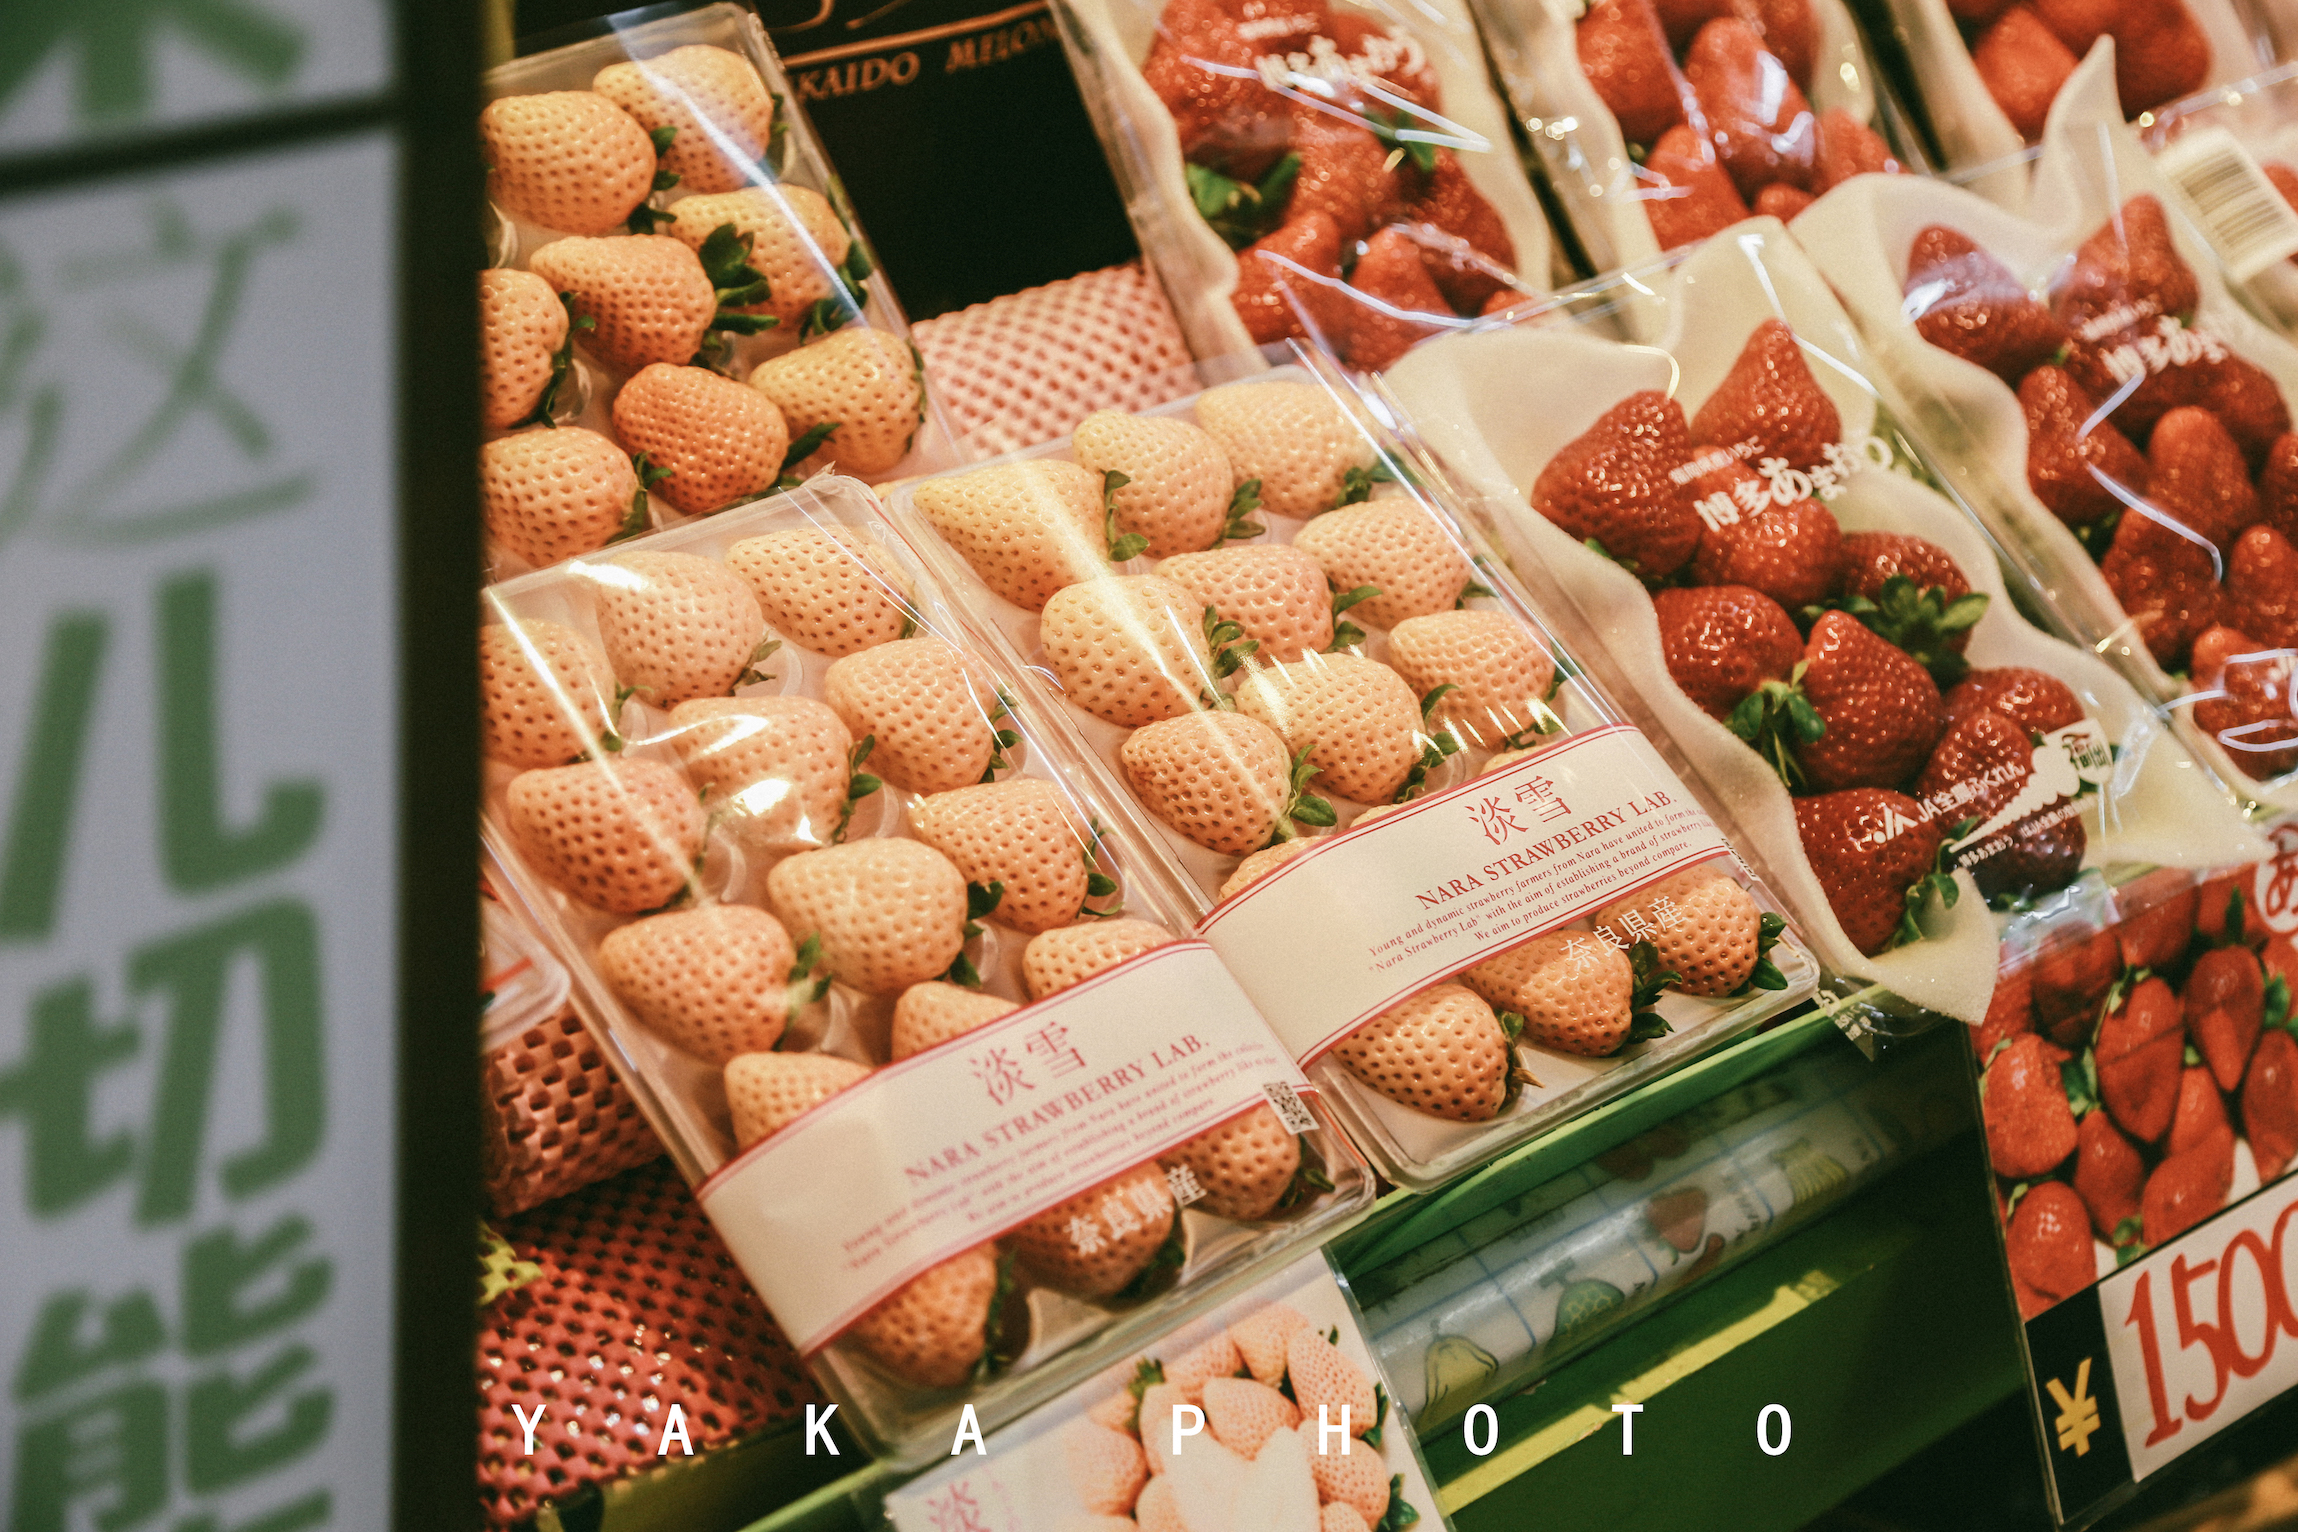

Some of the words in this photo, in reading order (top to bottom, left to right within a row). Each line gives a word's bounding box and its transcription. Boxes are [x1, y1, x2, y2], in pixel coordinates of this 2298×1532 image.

[793, 51, 922, 101] KAIDO
[1415, 873, 1485, 911] NARA
[1482, 806, 1628, 882] STRAWBERRY
[1628, 790, 1679, 817] LAB.
[1464, 775, 1572, 846] 淡雪
[1368, 934, 1406, 957] Young
[1404, 921, 1426, 940] and
[1425, 906, 1466, 930] dynamic
[1465, 885, 1516, 912] strawberry
[1515, 868, 1554, 893] farmers
[1552, 856, 1579, 876] from
[1575, 846, 1603, 860] Nara
[1600, 835, 1625, 851] have
[1625, 820, 1656, 841] united
[1664, 810, 1686, 826] form
[1403, 926, 1460, 957] Strawberry
[1485, 904, 1508, 920] with
[1506, 898, 1524, 911] the
[1524, 889, 1545, 904] aim
[1555, 858, 1614, 890] establishing
[1618, 839, 1649, 860] brand
[1660, 821, 1702, 842] strawberry
[1473, 929, 1491, 942] We
[1491, 921, 1512, 936] aim
[1522, 899, 1561, 924] produce
[1560, 873, 1619, 904] strawberries
[1616, 854, 1652, 878] beyond
[1652, 841, 1693, 862] compare.
[1560, 895, 1690, 972] 奈良県産
[903, 1140, 982, 1186] NARA
[982, 1058, 1147, 1149] STRAWBERRY
[1151, 1035, 1209, 1068] LAB.
[968, 1020, 1086, 1107] 淡雪
